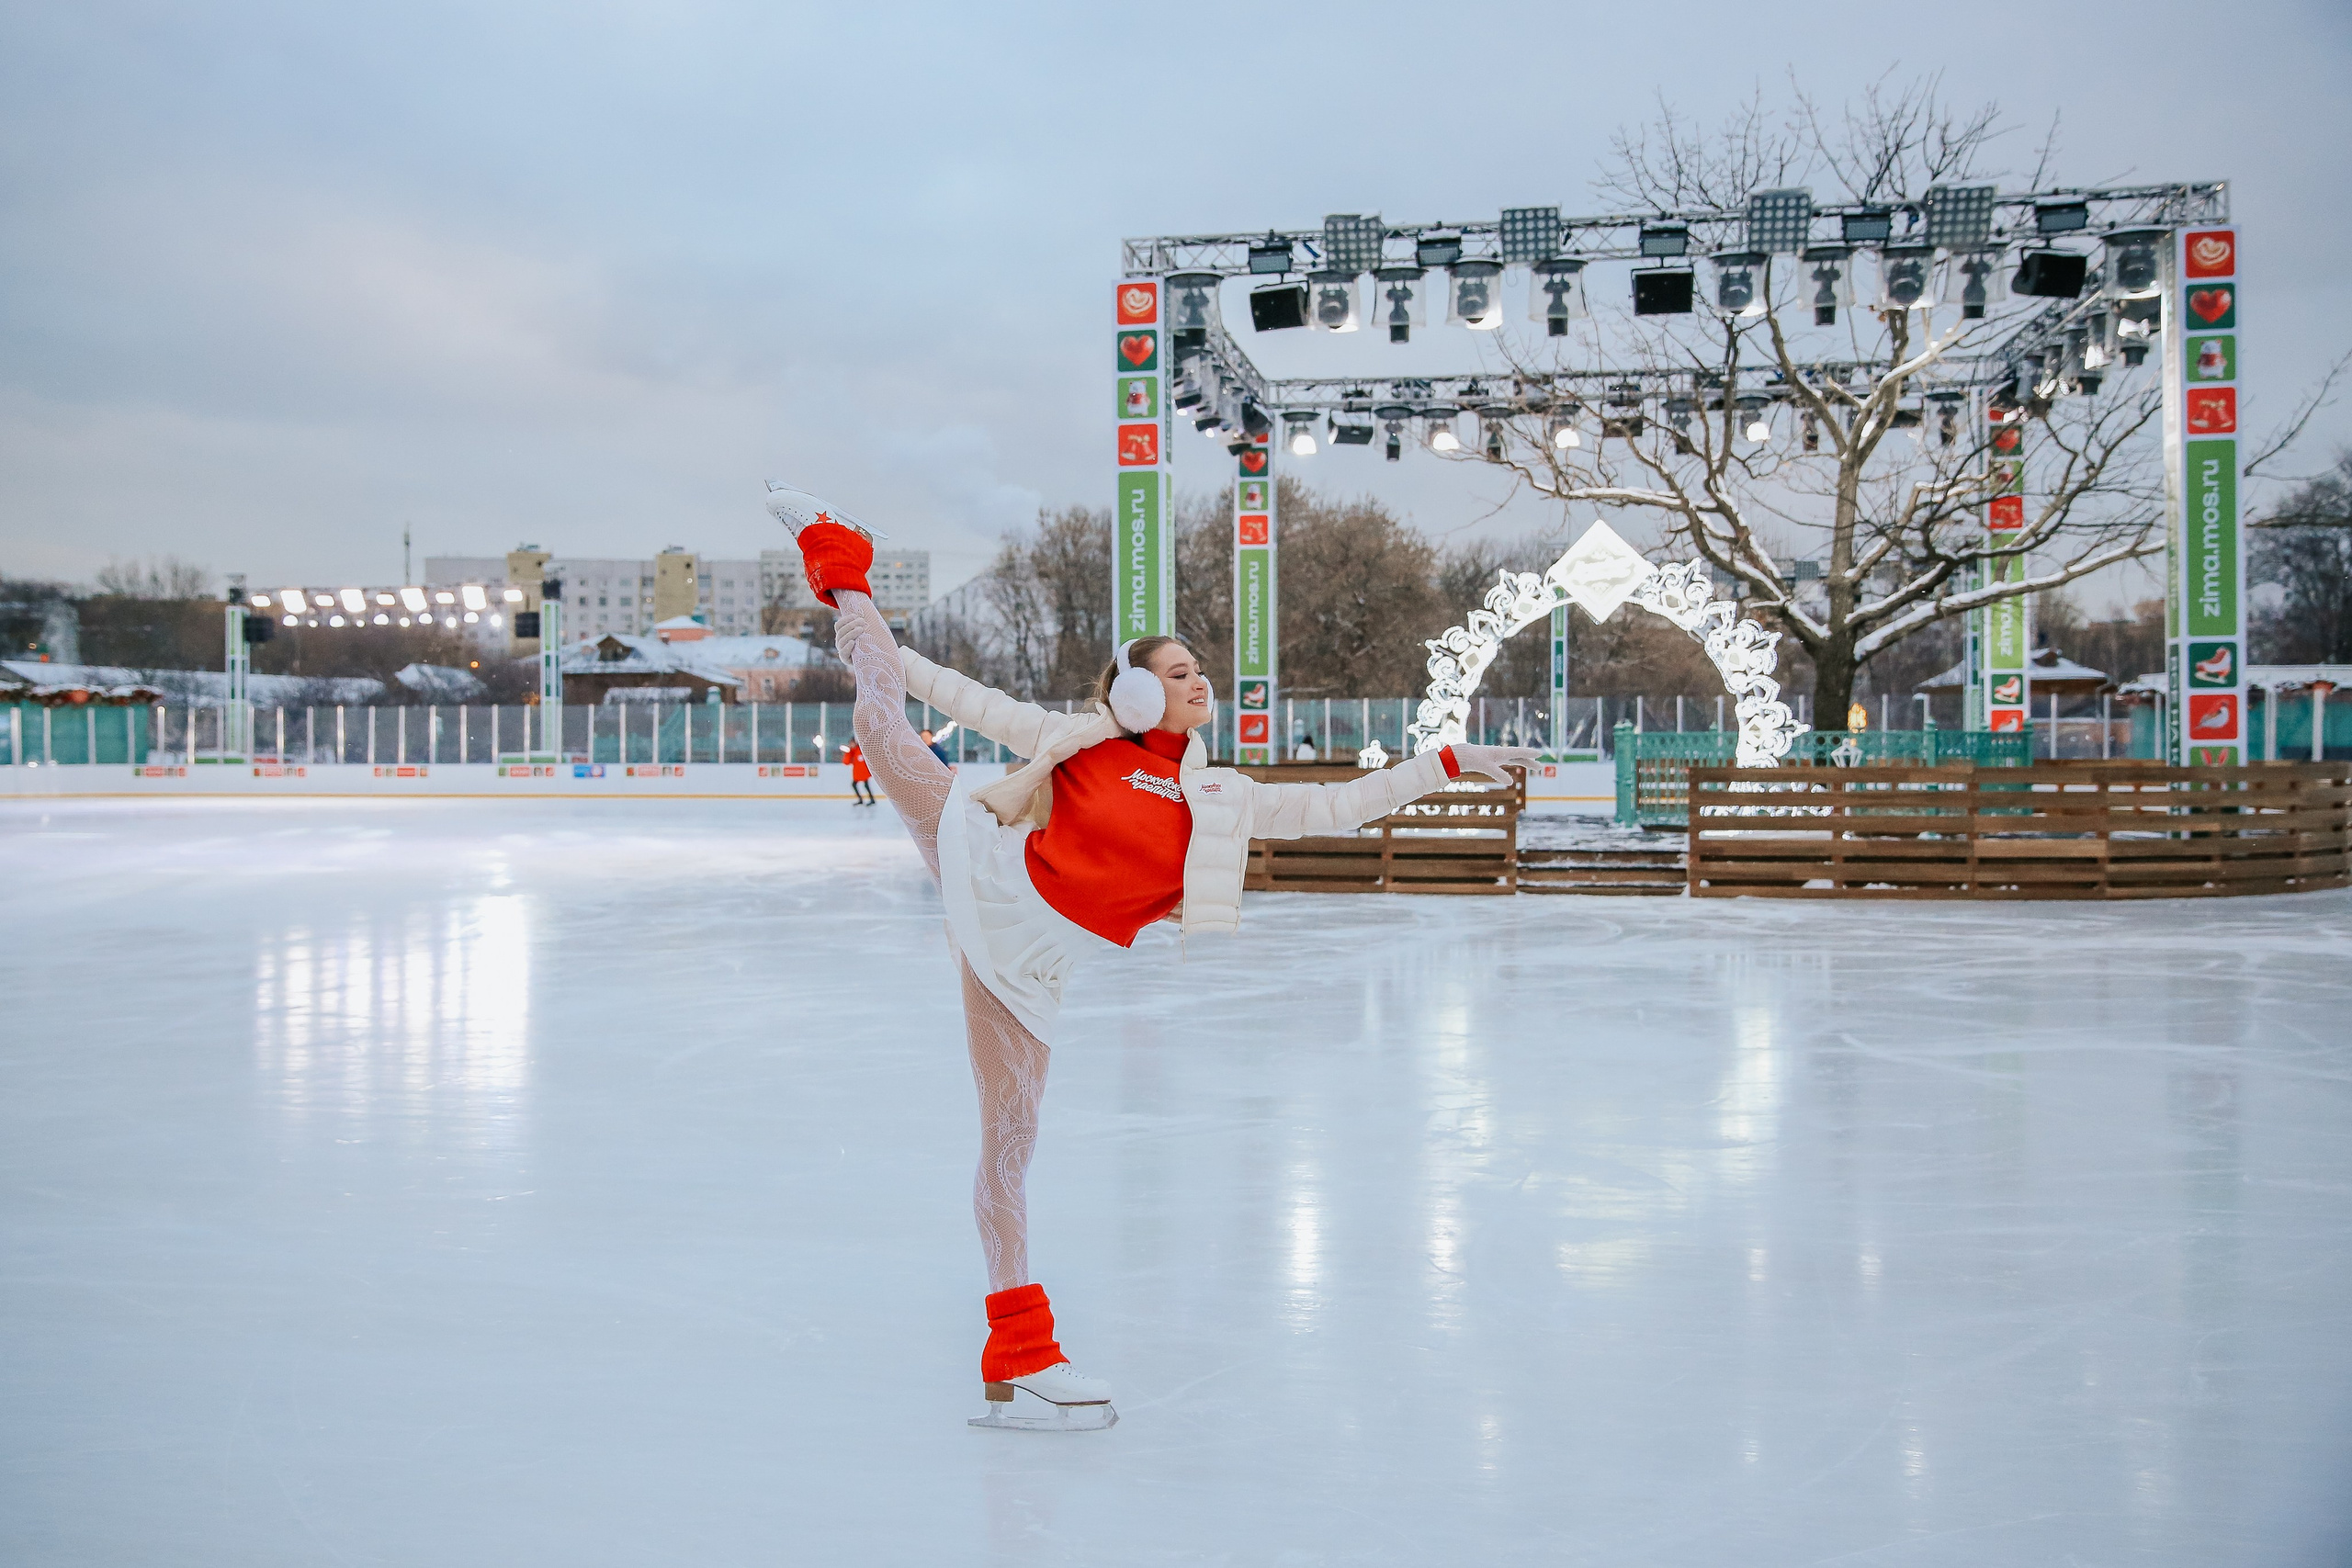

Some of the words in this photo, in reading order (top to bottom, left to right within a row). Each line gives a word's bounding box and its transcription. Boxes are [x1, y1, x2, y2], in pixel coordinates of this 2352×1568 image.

[1128, 488, 1147, 633] zima.mos.ru
[2199, 458, 2221, 617] zima.mos.ru
[1245, 560, 1260, 664] zima.mos.ru
